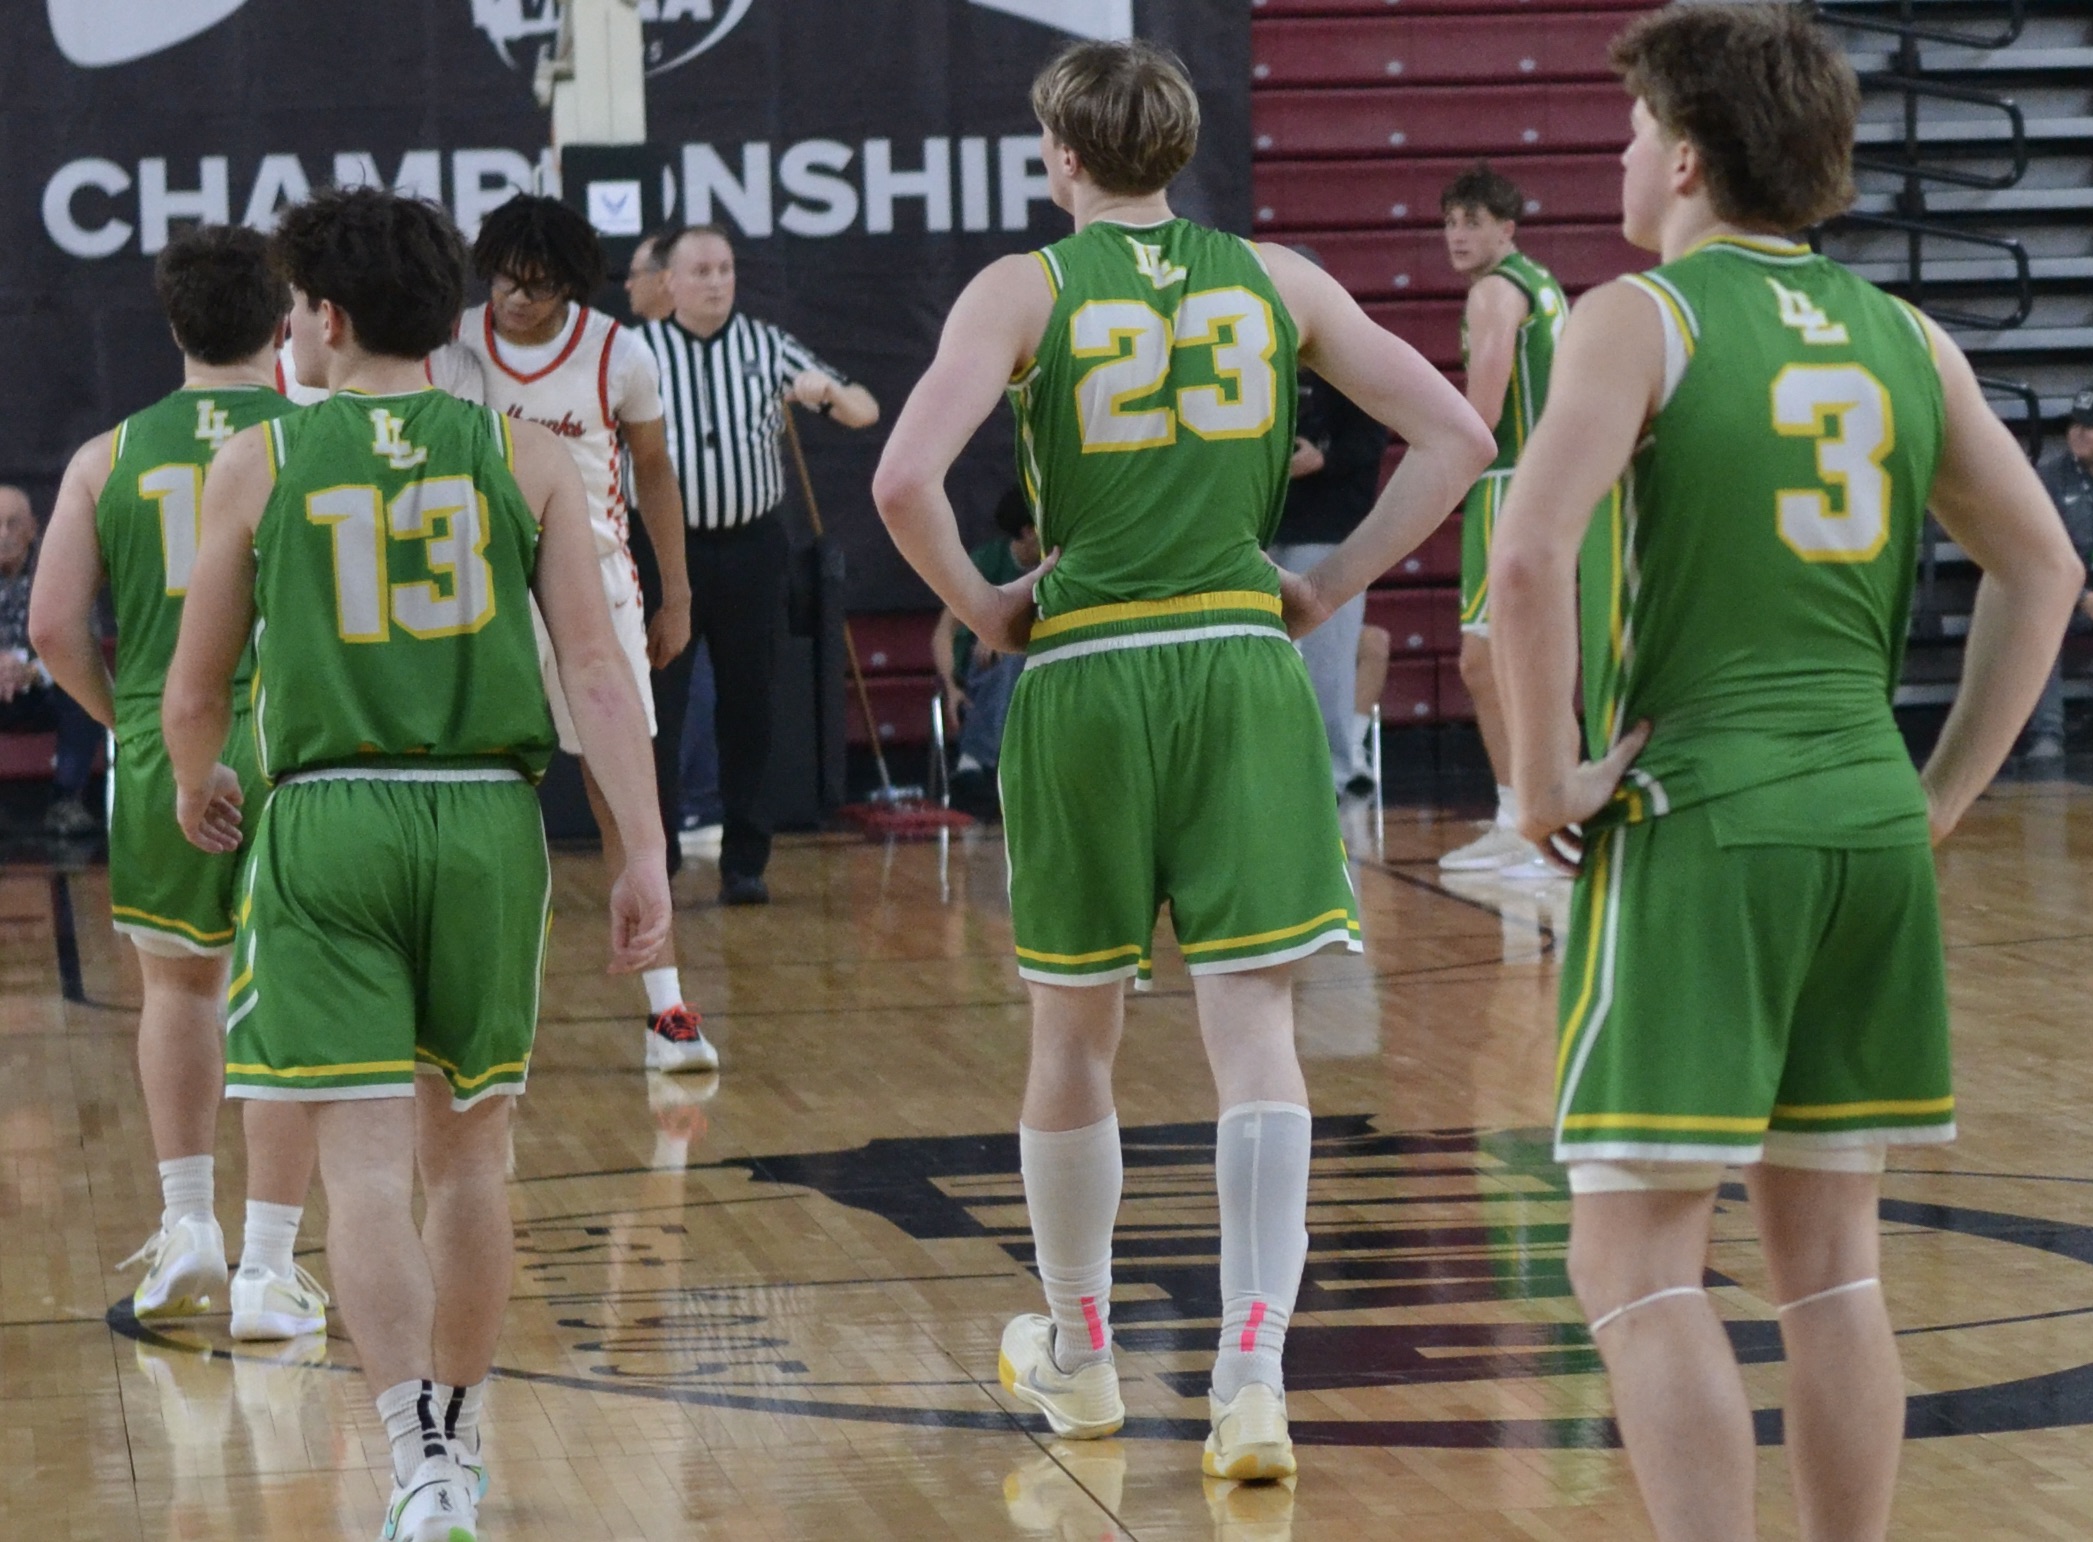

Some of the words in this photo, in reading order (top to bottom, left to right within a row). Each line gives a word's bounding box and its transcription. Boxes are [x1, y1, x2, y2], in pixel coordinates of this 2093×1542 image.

[42, 136, 1052, 258] CHAPNSHIP
[1069, 285, 1277, 454] 23
[137, 462, 213, 597] 1
[1771, 362, 1895, 564] 3
[306, 474, 497, 644] 13
